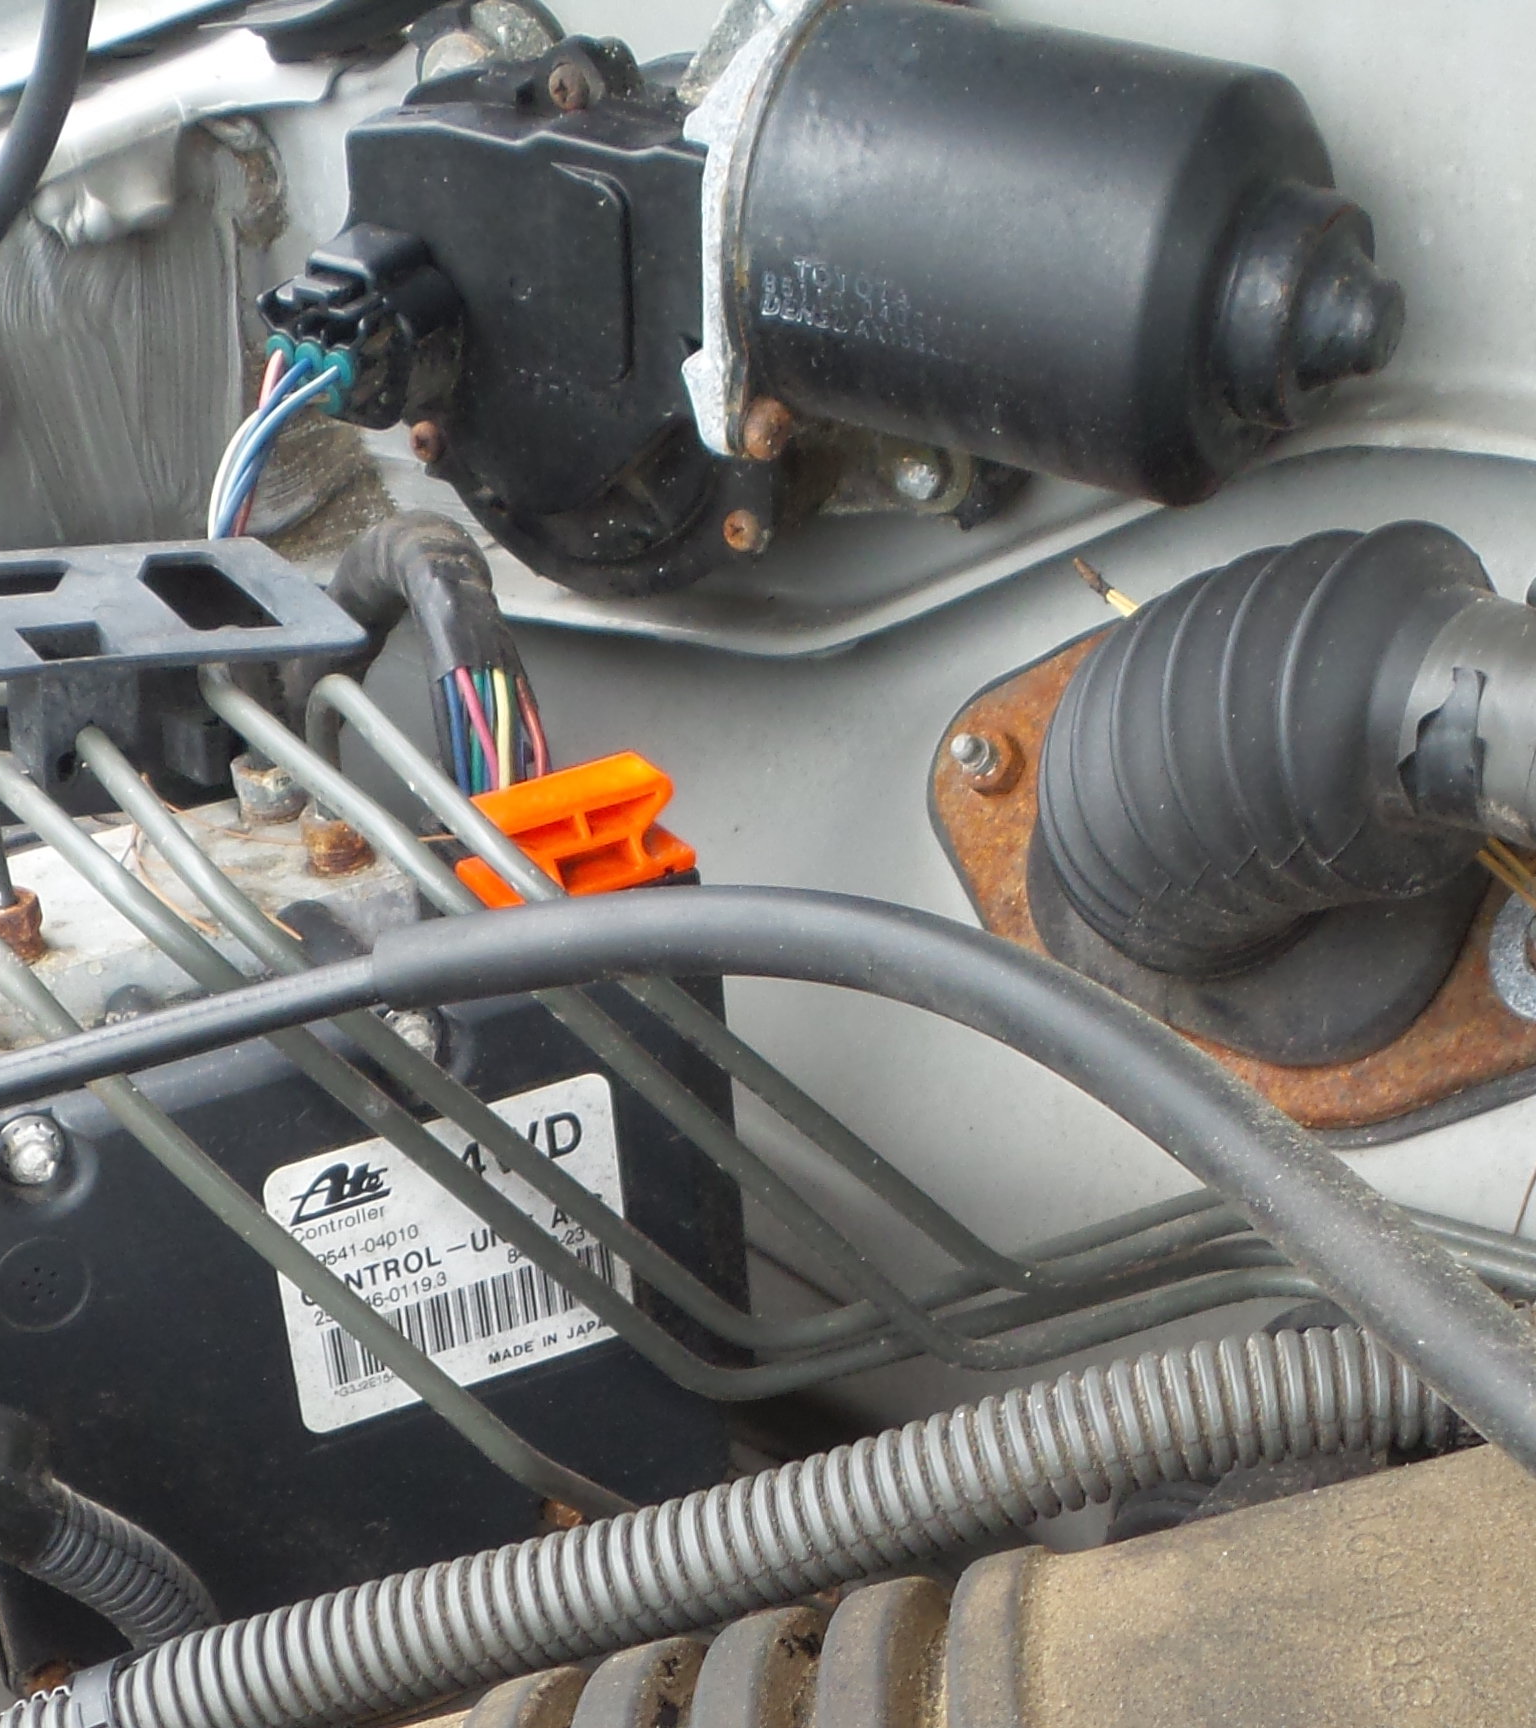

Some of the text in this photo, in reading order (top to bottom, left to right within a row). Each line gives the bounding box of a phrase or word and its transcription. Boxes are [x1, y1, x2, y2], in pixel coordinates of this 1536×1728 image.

[461, 1112, 582, 1177] 4D
[291, 1206, 386, 1243] Controller
[316, 1223, 419, 1267] 9541-04010
[488, 1317, 608, 1365] MADE IN JAPA
